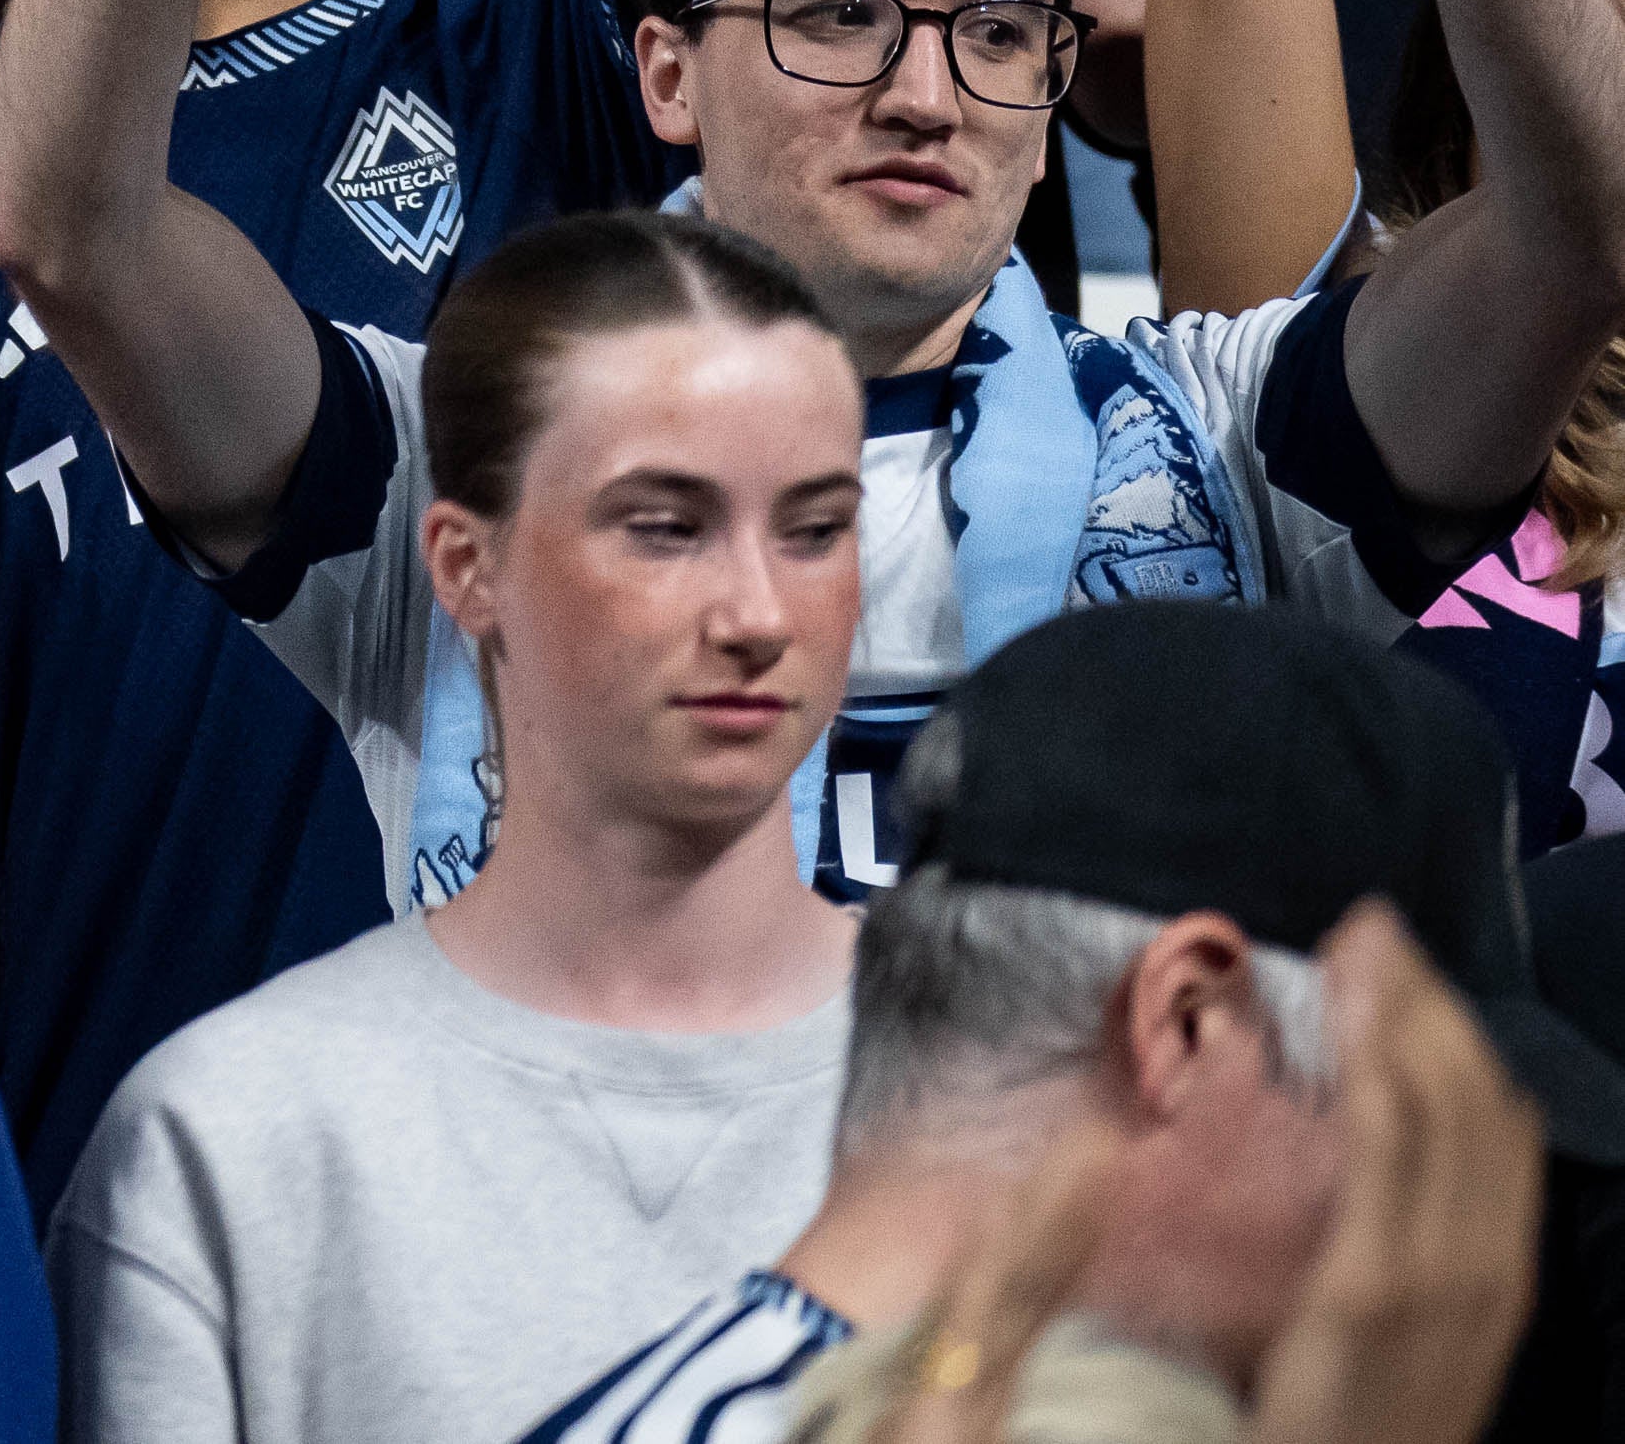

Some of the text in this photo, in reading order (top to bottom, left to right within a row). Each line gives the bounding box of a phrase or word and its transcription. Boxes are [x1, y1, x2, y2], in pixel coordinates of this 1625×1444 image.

[336, 162, 458, 198] WHITECAP
[361, 151, 445, 180] VANCOUVER
[393, 191, 425, 212] FC
